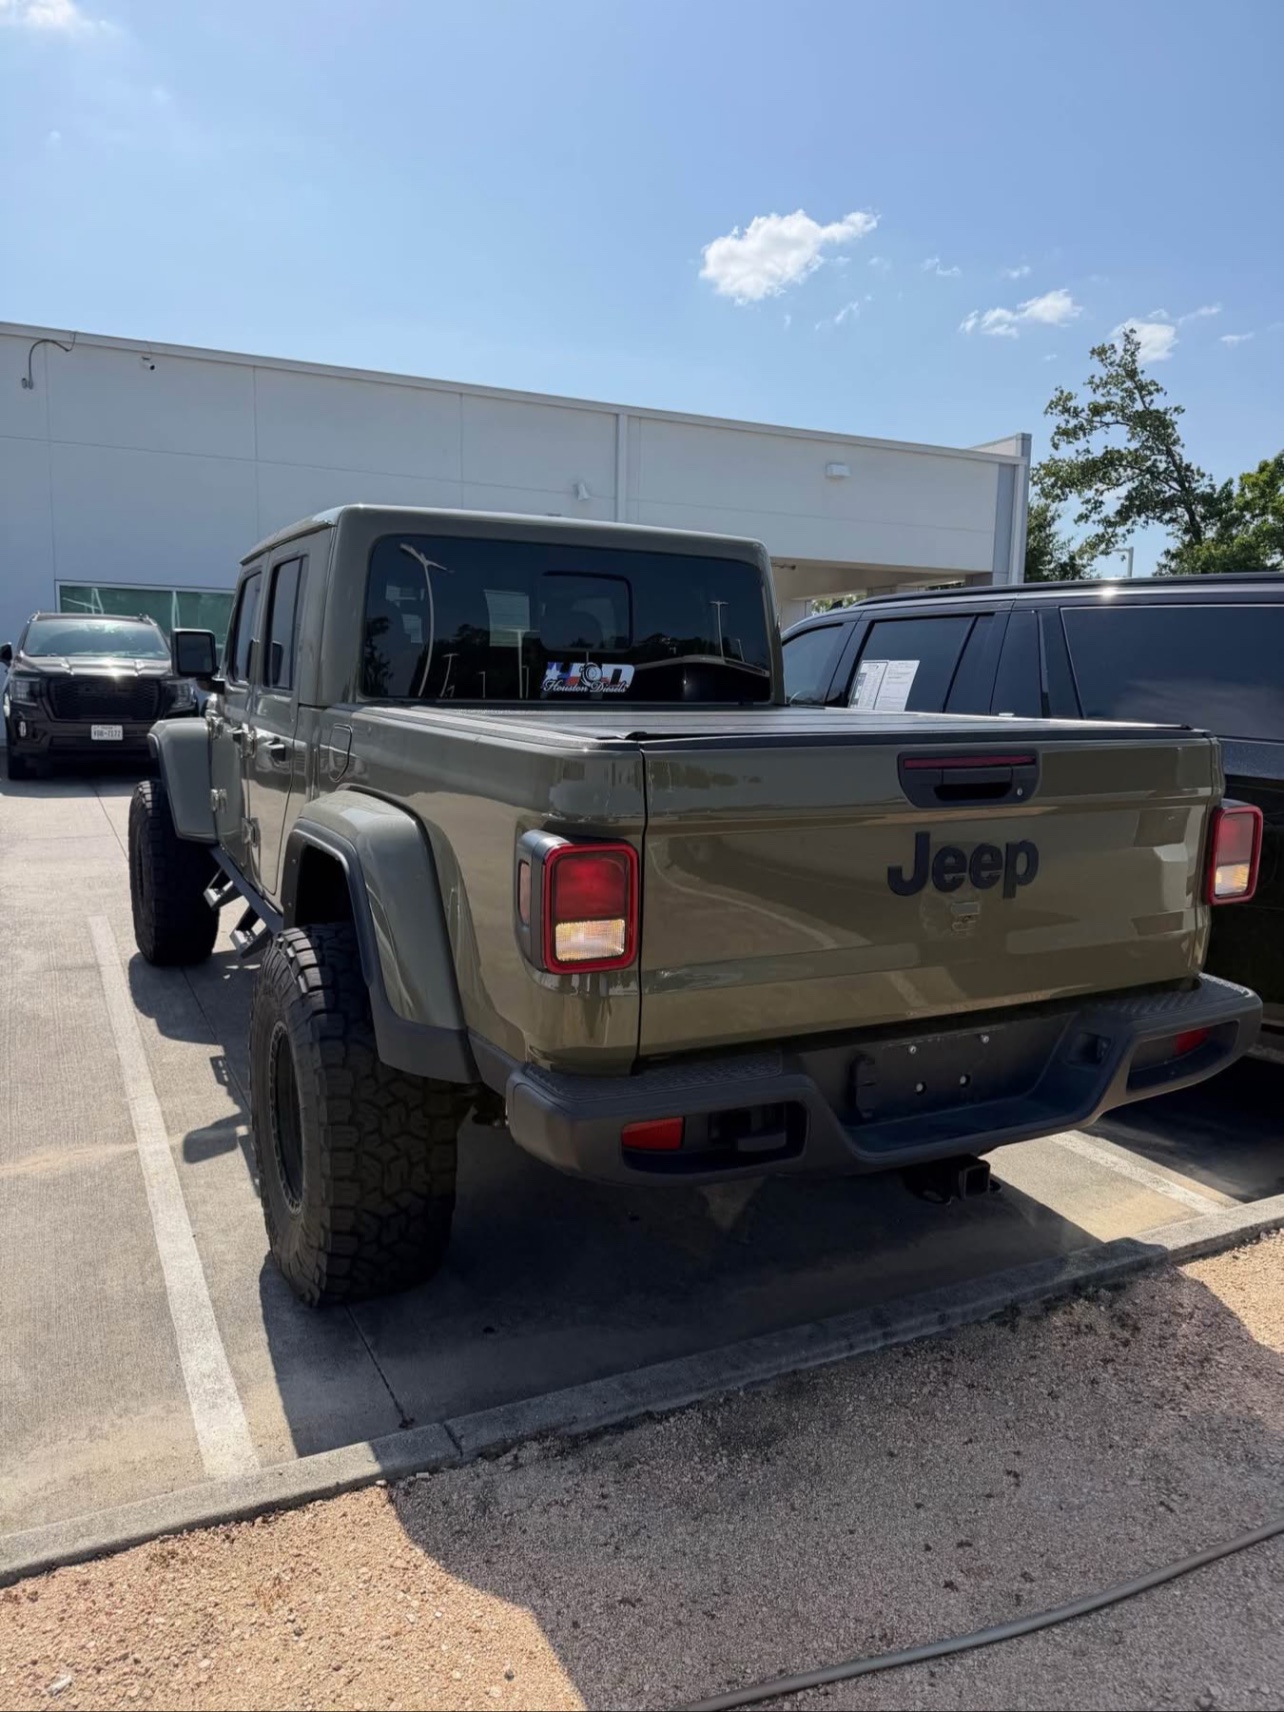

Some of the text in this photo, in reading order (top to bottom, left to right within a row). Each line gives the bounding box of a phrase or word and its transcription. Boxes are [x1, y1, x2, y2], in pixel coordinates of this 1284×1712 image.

[543, 680, 626, 692] Houston Diesels
[887, 831, 1039, 899] Jeep
